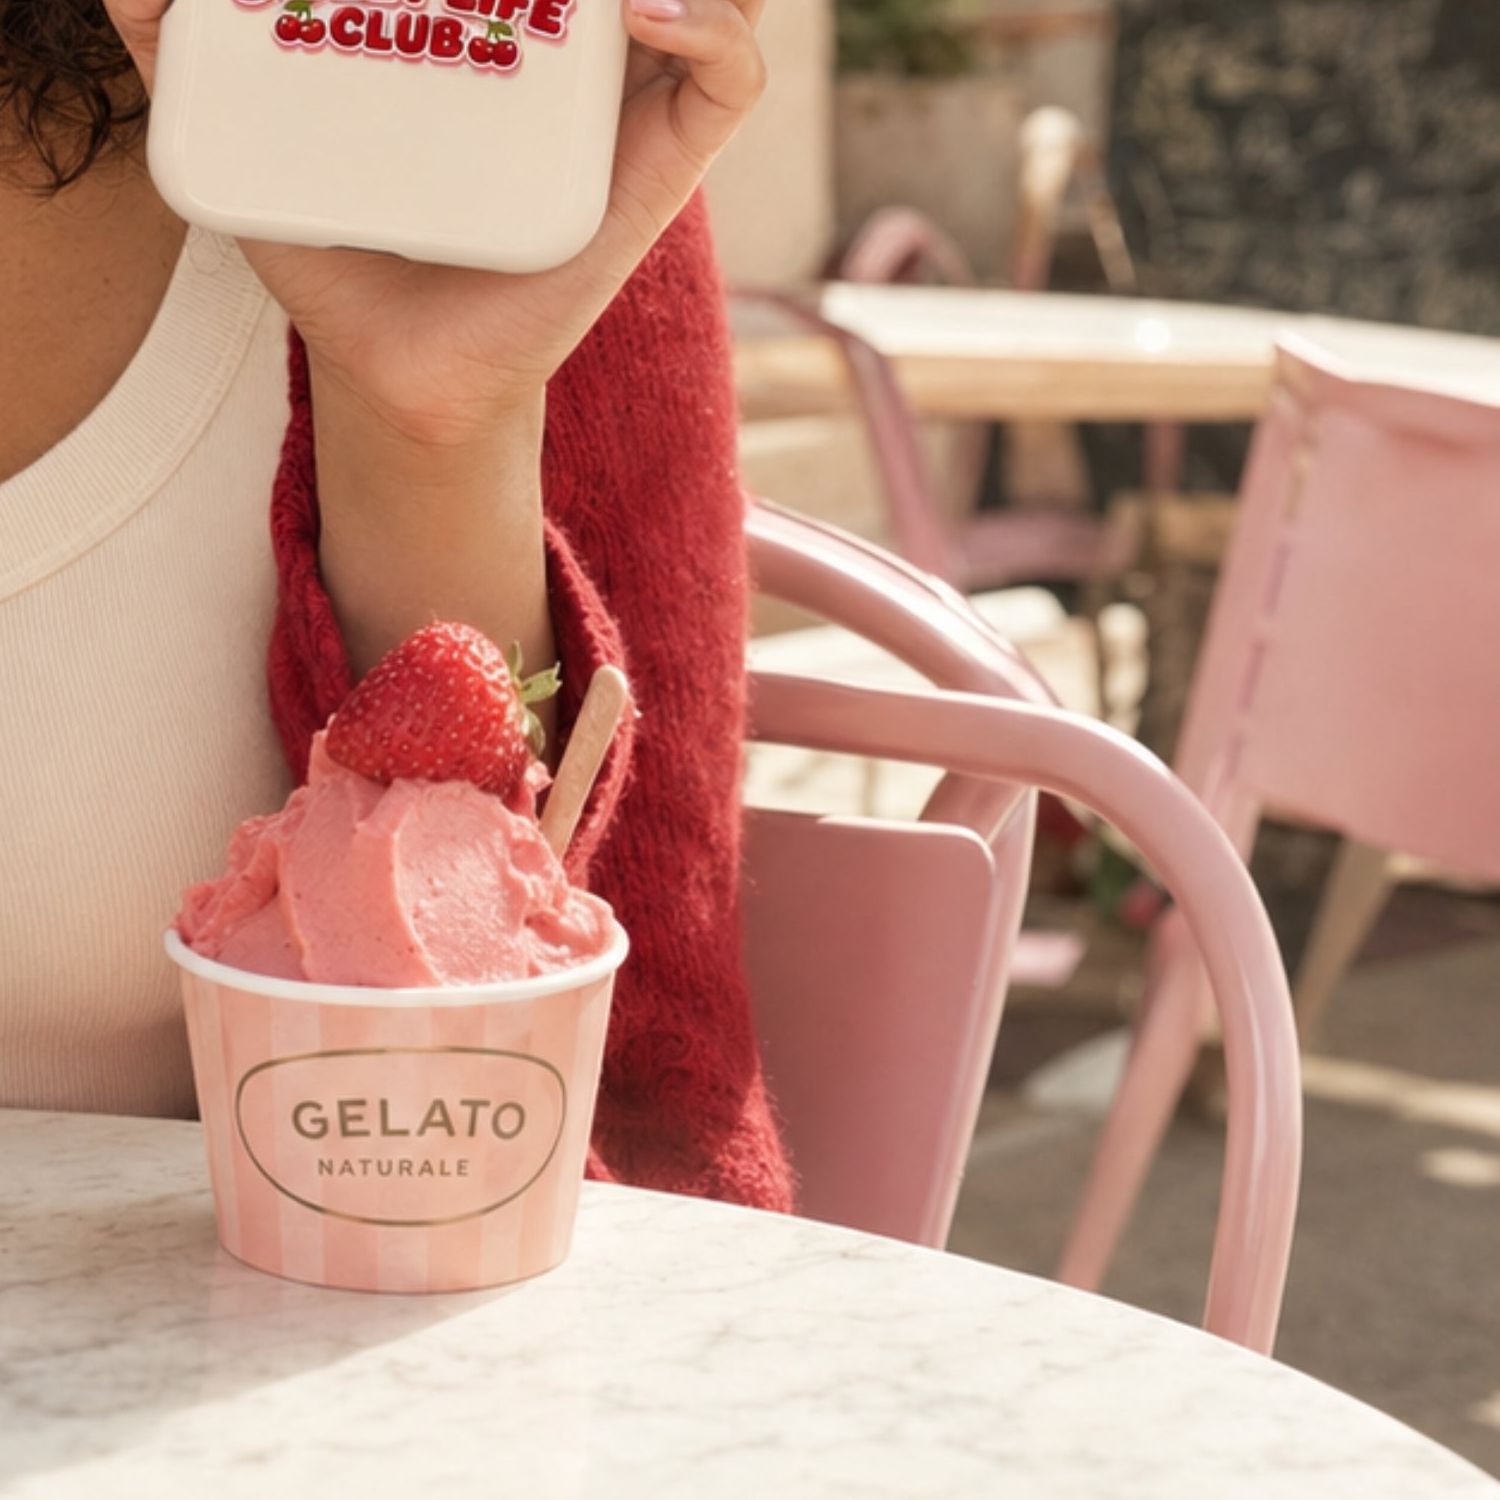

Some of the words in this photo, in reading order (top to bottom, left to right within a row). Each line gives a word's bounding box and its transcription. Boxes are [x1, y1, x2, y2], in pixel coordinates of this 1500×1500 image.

[329, 6, 464, 59] CLUB
[290, 1097, 527, 1140] GELATO
[317, 1158, 470, 1178] NATURALE
